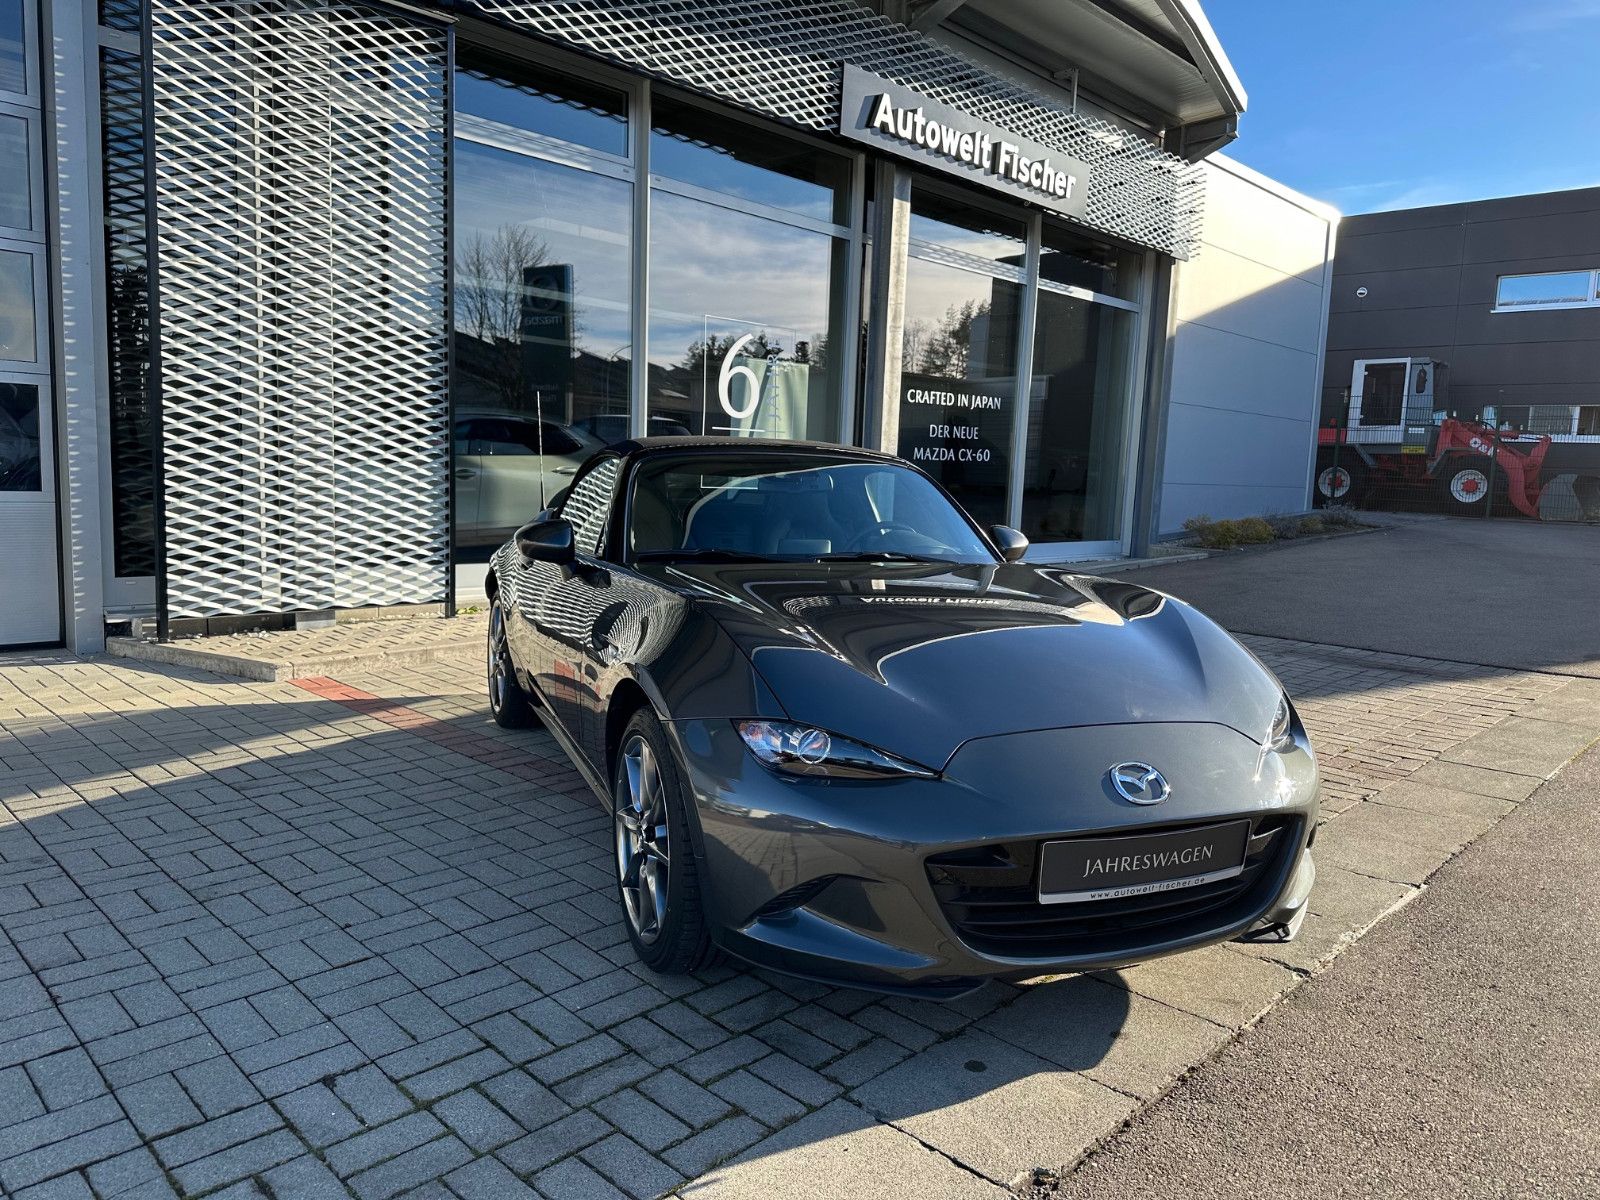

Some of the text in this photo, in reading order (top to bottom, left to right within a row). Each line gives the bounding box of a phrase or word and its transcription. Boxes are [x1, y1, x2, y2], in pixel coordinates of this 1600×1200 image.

[872, 92, 1077, 199] Autowelt Fischer
[718, 332, 761, 419] 6
[907, 389, 1001, 410] CRAFTED IN JAPAN
[929, 424, 979, 440] DER NEUE
[913, 447, 991, 461] MAZDA CX-60
[1082, 844, 1214, 878] JAHRESWAGEN
[1090, 877, 1205, 900] www.autowelt-fischer.de
